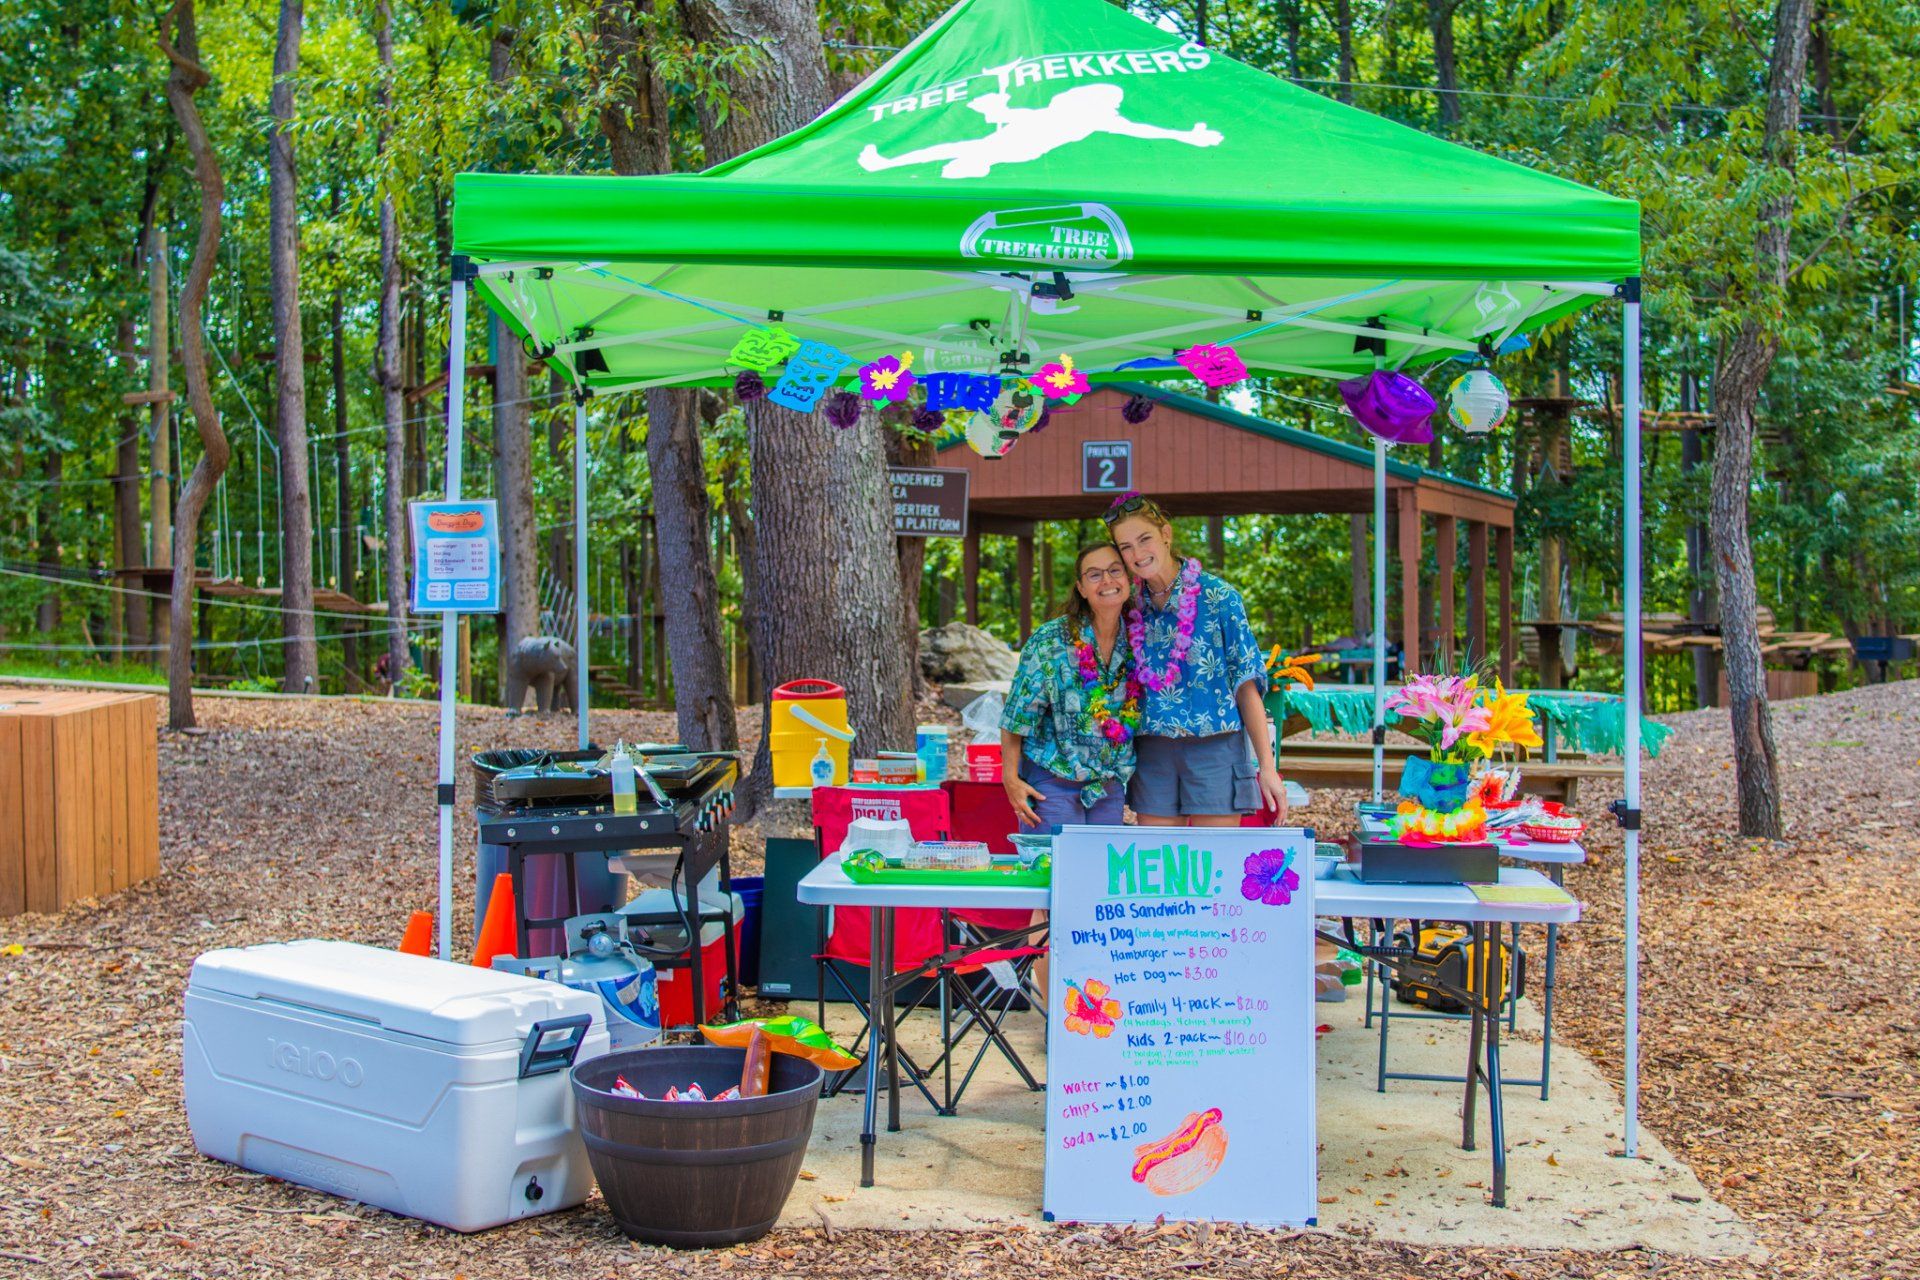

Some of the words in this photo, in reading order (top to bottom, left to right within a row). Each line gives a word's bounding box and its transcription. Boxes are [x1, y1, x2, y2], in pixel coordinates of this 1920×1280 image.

[867, 81, 968, 122] TREE
[983, 42, 1211, 95] TREKKERS
[1050, 226, 1110, 247] TREE
[980, 238, 1108, 261] TREKKERS
[1087, 445, 1128, 458] PAVILION
[1098, 459, 1116, 488] 2
[906, 517, 960, 532] PLATFORM
[1107, 842, 1223, 896] MENU:
[1095, 904, 1126, 921] BBQ
[1131, 900, 1196, 919] Sandwich
[1212, 902, 1243, 917] $7.00
[1071, 929, 1107, 946] Dirty
[1110, 926, 1135, 946] Dog
[1230, 927, 1267, 944] $8.00
[1110, 948, 1169, 963] Hamburger
[1188, 946, 1228, 960] $5.00
[1114, 971, 1137, 985] Hot
[1143, 969, 1167, 984] Dog
[1184, 966, 1218, 980] $3.00
[1128, 998, 1167, 1017] Family
[1171, 996, 1222, 1013] 4-pack
[1236, 997, 1269, 1012] $21.00
[1127, 1033, 1156, 1048] Kids
[1164, 1032, 1209, 1046] 2-pack
[1223, 1029, 1268, 1046] $10.00
[267, 1037, 364, 1088] IGLOO
[1063, 1080, 1102, 1095] water
[1119, 1075, 1150, 1091] $1.00
[1062, 1099, 1099, 1119] chips
[1117, 1095, 1152, 1112] $2.00
[1062, 1131, 1096, 1150] soda
[1110, 1122, 1148, 1141] $2.00
